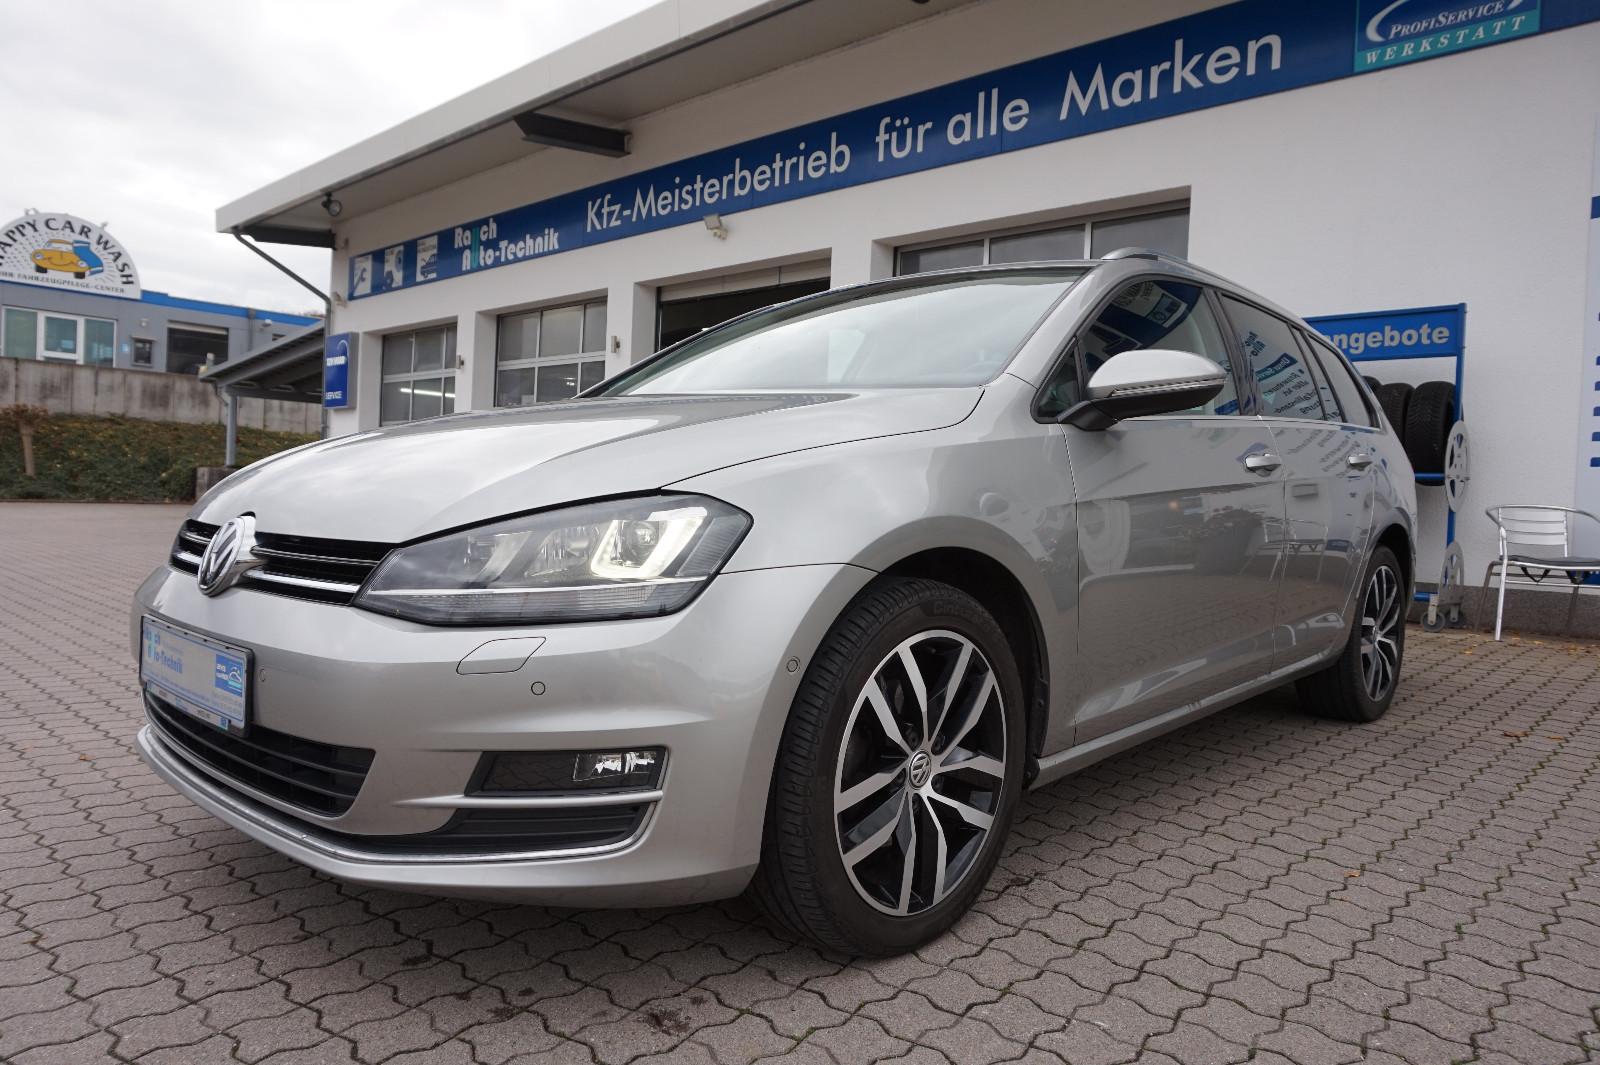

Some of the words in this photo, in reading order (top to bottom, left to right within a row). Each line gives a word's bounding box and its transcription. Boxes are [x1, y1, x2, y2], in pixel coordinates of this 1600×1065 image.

[1366, 16, 1525, 65] WERKSTATT
[586, 132, 851, 233] Kfz-Meisterbetrieb
[875, 116, 933, 162] für
[946, 87, 1030, 146] alle
[1059, 33, 1282, 121] Marken
[44, 217, 92, 239] CAR
[96, 234, 135, 285] WASH
[1323, 322, 1450, 355] ngebote
